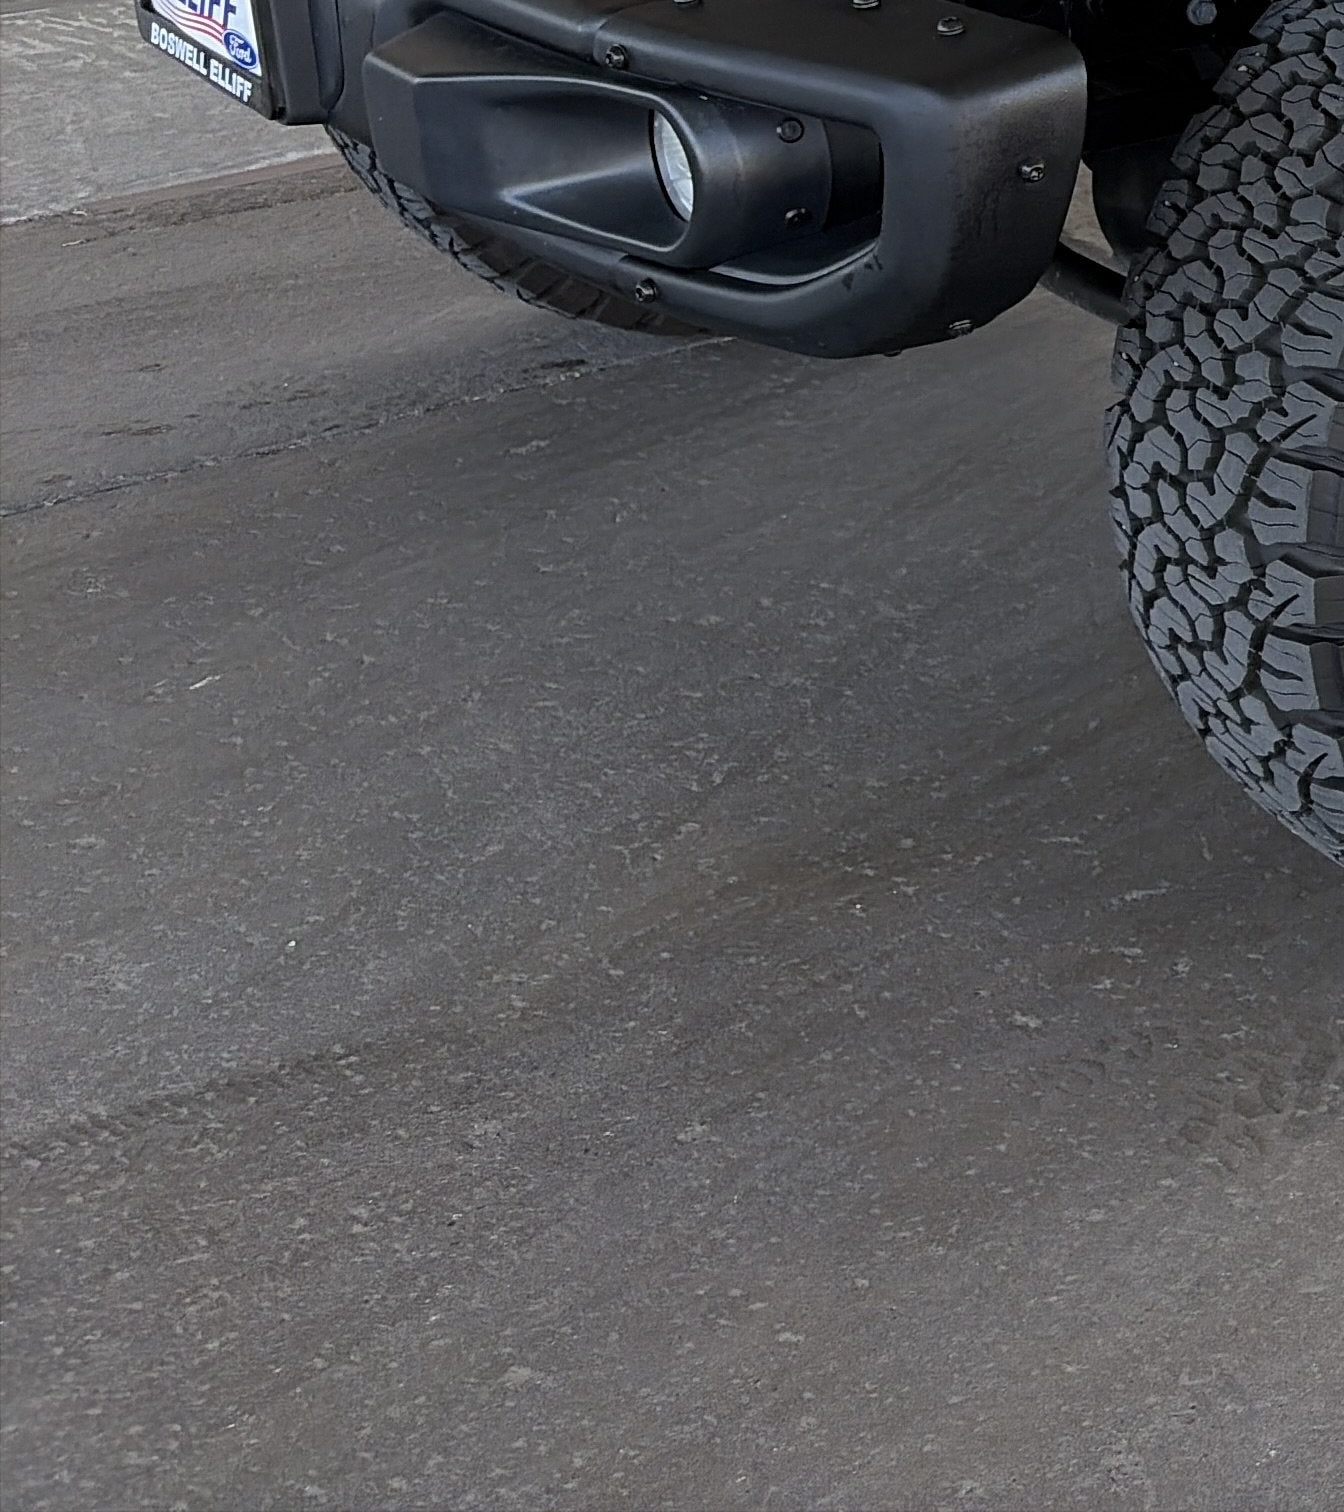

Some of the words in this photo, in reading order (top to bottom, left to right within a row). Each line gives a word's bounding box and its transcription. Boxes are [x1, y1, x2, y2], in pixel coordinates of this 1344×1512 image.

[151, 22, 208, 75] BOSWELL
[209, 59, 253, 103] ELLIFF
[229, 34, 252, 63] Ford
